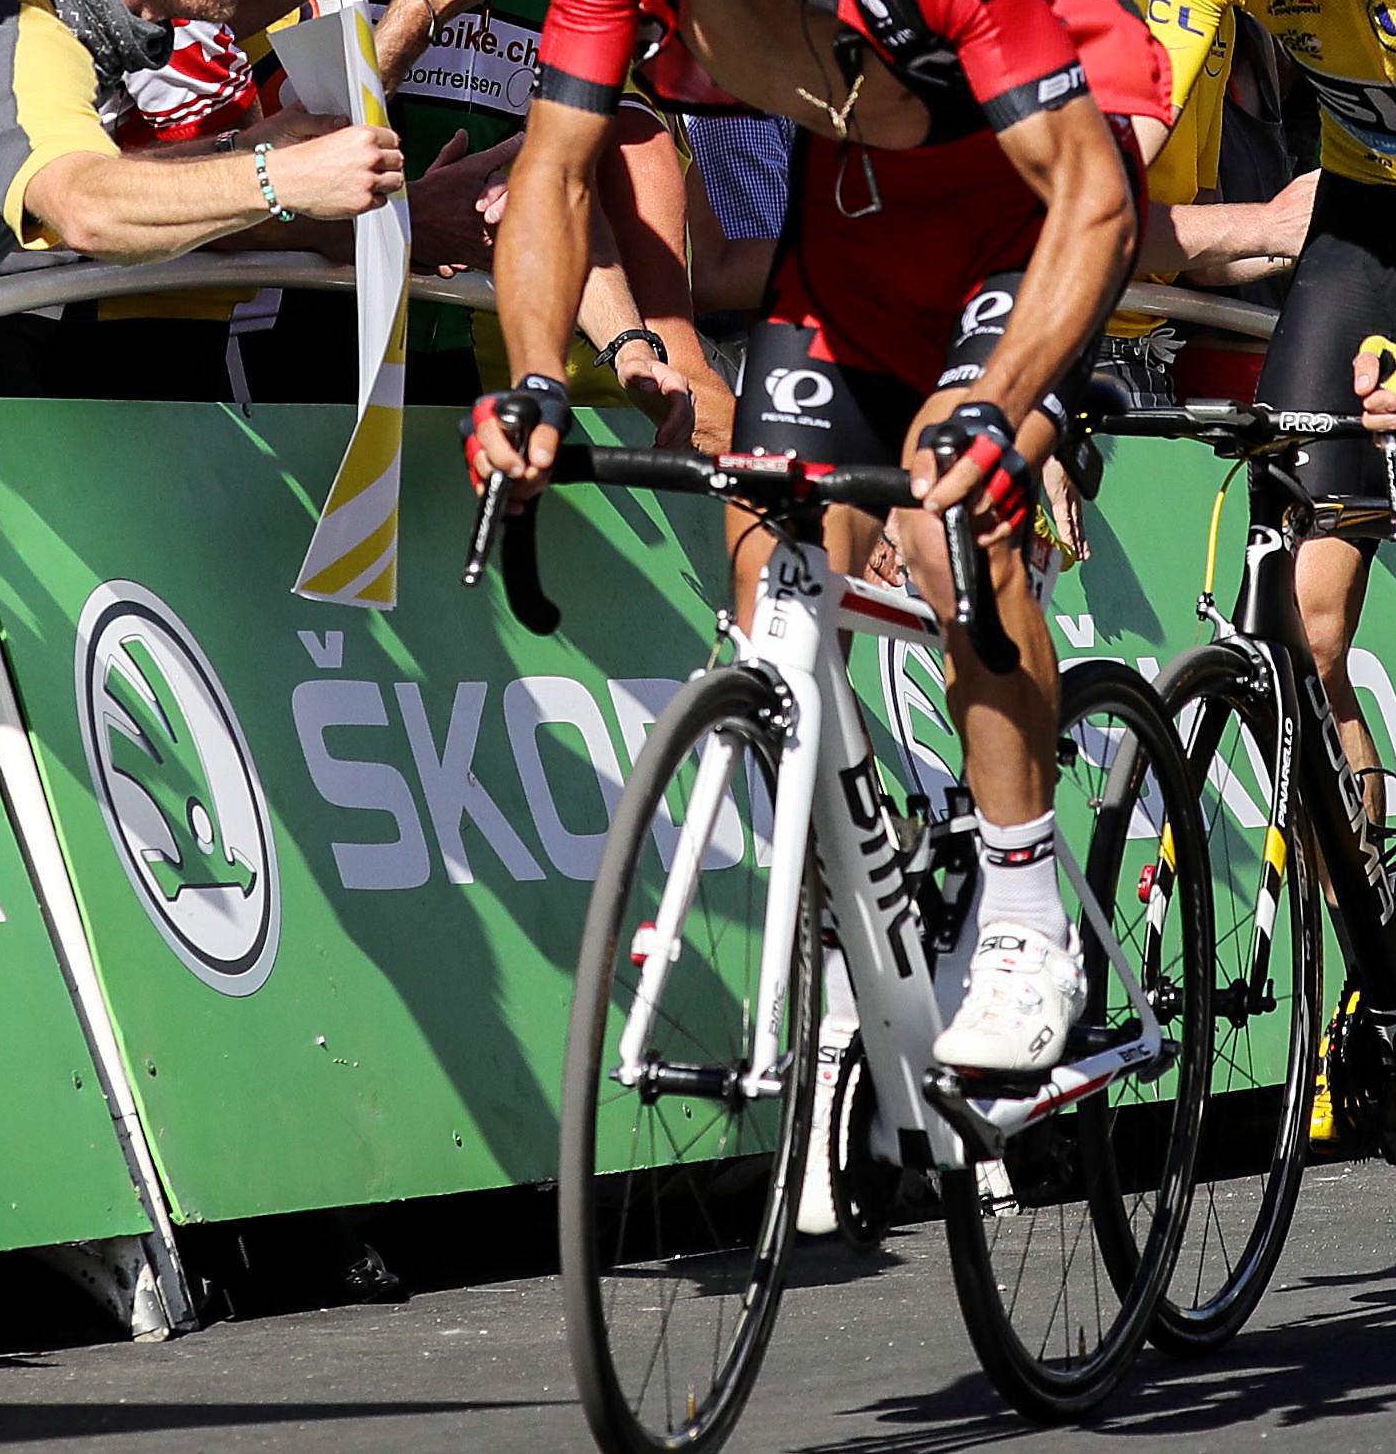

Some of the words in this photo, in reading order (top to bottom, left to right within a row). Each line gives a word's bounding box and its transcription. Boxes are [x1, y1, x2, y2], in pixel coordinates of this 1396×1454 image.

[839, 752, 914, 981] BMC
[1278, 716, 1293, 828] PINARELLO
[1305, 674, 1395, 926] DOGMA
